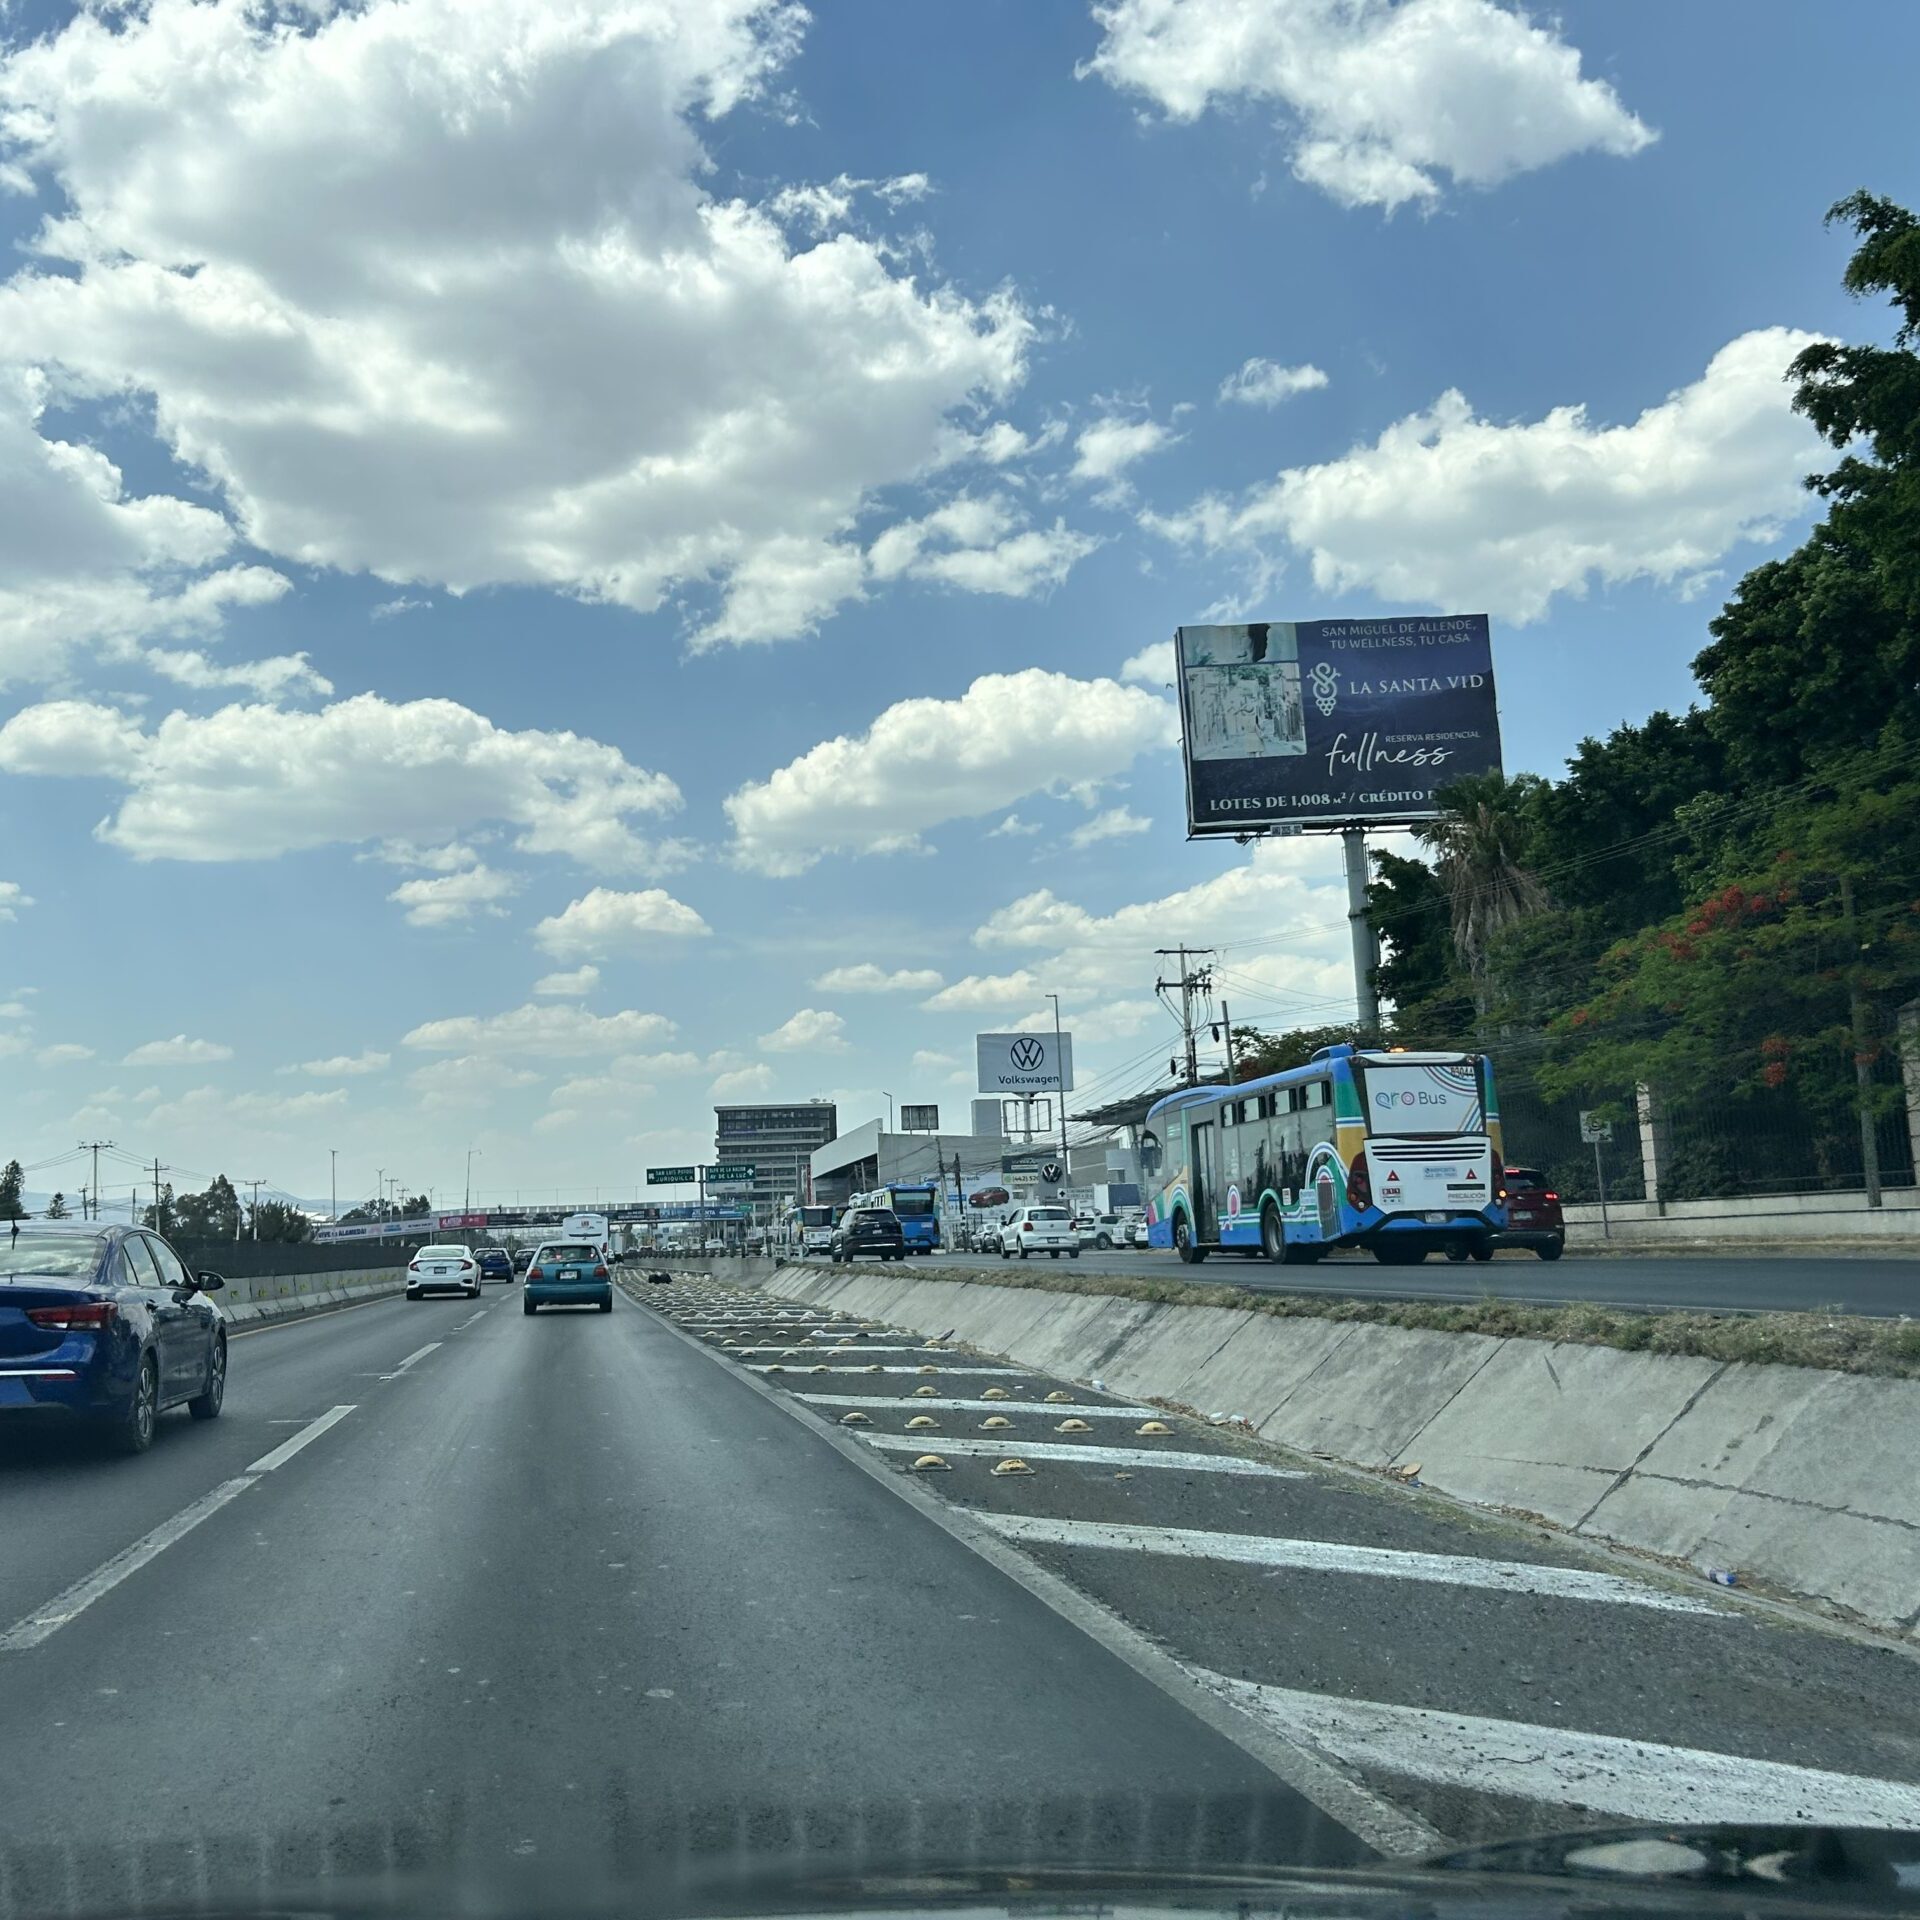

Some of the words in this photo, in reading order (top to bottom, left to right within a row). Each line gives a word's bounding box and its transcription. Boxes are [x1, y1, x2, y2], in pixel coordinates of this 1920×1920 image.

[1322, 626, 1346, 637] SAN
[1350, 624, 1396, 636] MIGUEL
[1400, 622, 1414, 634] DE
[1330, 640, 1346, 650] TU
[1419, 635, 1435, 646] TU
[1438, 633, 1471, 645] CASA
[1350, 681, 1372, 695] LA
[1380, 678, 1441, 694] SANTA
[1447, 674, 1484, 689] VID
[1385, 734, 1424, 743] RESERVA
[1425, 730, 1481, 741] RESIDENCIAL
[1324, 732, 1454, 776] fullness
[1210, 798, 1261, 811] LOTES
[1266, 796, 1288, 808] DE
[1358, 789, 1424, 803] CRÉDITO
[998, 1075, 1060, 1086] Volkswagen
